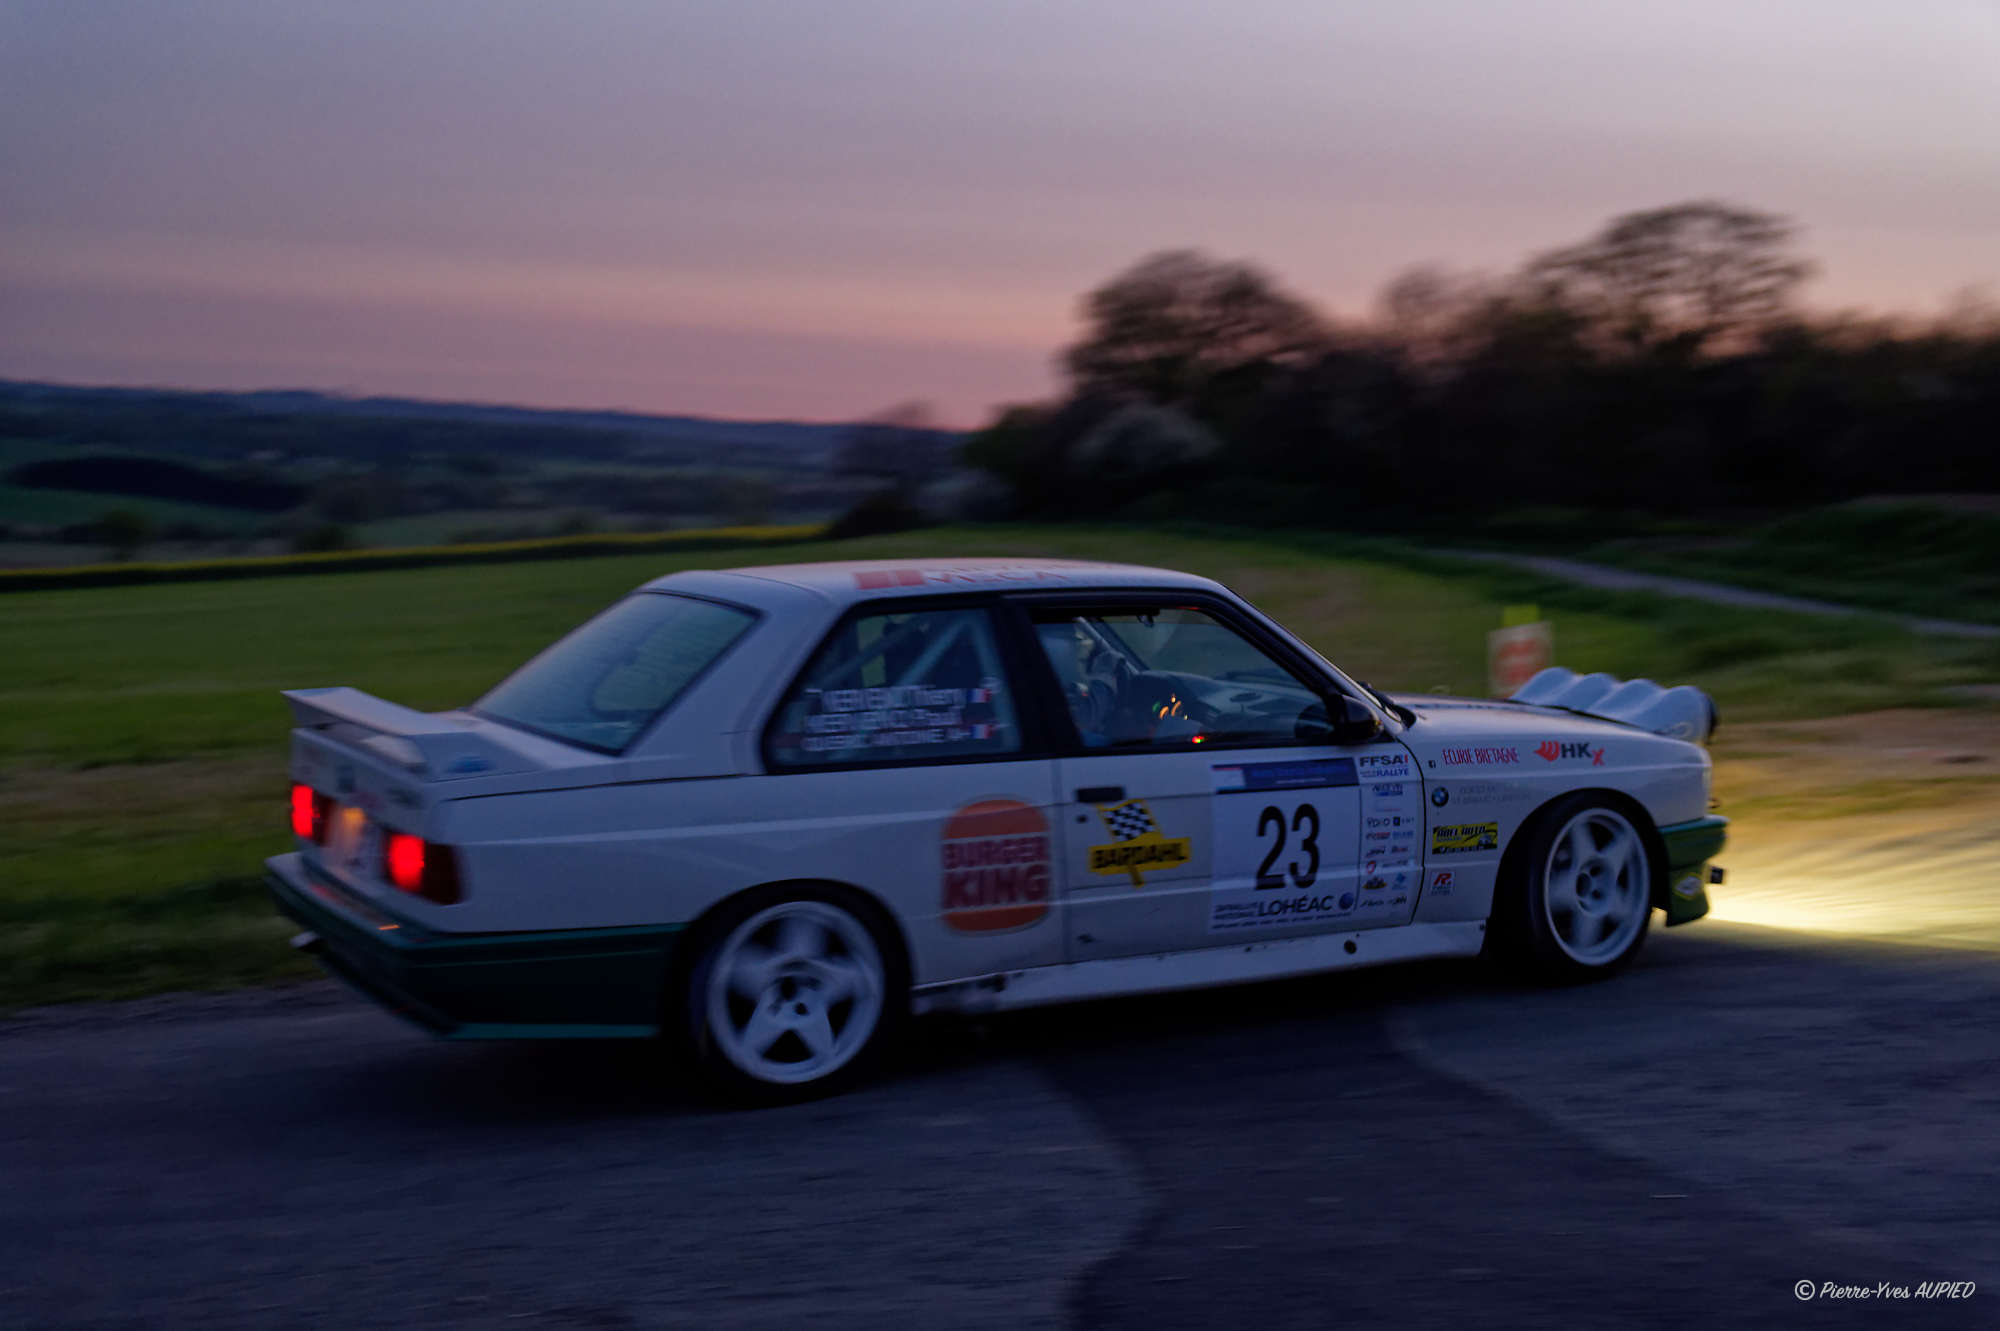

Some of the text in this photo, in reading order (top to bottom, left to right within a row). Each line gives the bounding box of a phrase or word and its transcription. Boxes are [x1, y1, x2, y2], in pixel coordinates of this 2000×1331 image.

[1360, 754, 1403, 767] FFSA
[1475, 746, 1520, 764] BRETAGNE
[1376, 767, 1409, 778] RALLYE
[942, 837, 1049, 869] BURGER
[1093, 842, 1187, 869] BARDAHL
[1255, 803, 1320, 890] 23
[942, 863, 1049, 910] KING
[1258, 894, 1335, 917] LOHÉAC
